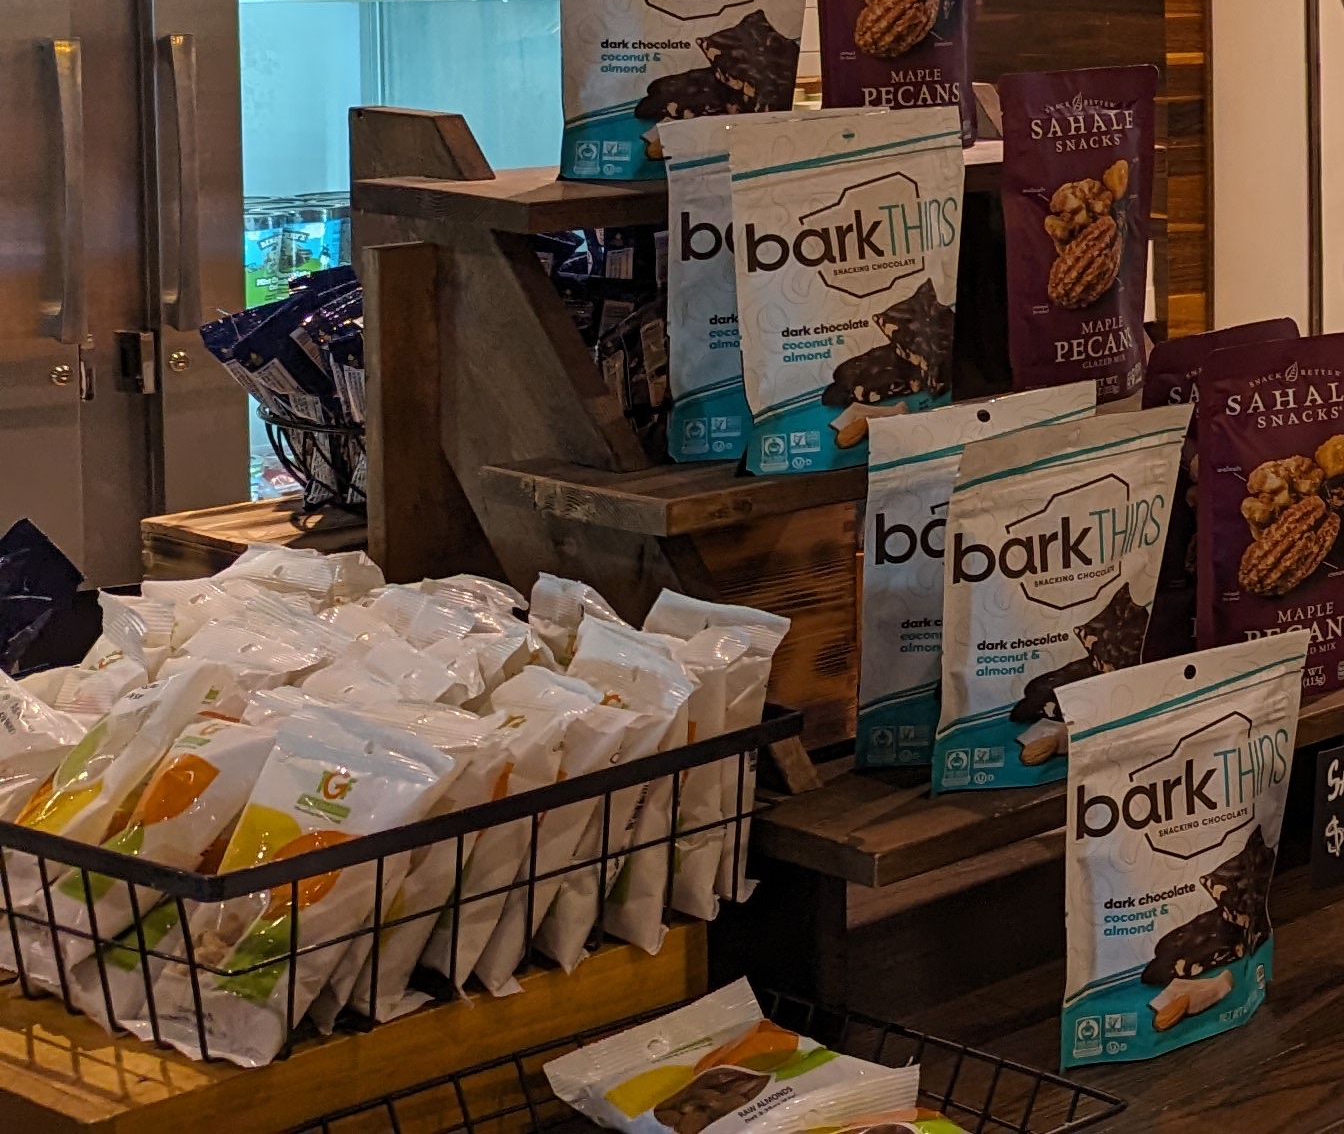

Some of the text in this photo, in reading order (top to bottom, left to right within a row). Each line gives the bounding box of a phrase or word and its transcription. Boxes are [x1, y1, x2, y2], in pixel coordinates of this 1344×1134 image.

[601, 39, 691, 49] dark chocolate
[601, 53, 661, 61] coconut &
[601, 64, 646, 73] almond
[891, 69, 941, 83] MAPLE
[862, 83, 960, 107] PECANS
[1031, 110, 1133, 139] SAHALE
[1056, 134, 1122, 152] SNACKS
[782, 319, 869, 338] dark chocolate
[1081, 316, 1124, 334] MAPLE
[782, 335, 845, 351] coconut &
[783, 349, 831, 362] almond
[1258, 406, 1339, 428] SNACKS
[1277, 602, 1333, 623] MAPLE
[977, 632, 1069, 651] dark chocolate
[1319, 643, 1336, 652] MIX
[977, 650, 1040, 664] coconut &
[976, 664, 1024, 676] almond
[1158, 808, 1248, 837] SNACKING CHOCOLATE
[1104, 883, 1195, 910] dark chocolate
[1104, 904, 1168, 923] coconut &
[1104, 922, 1154, 936] almond
[738, 1106, 756, 1117] RAW
[757, 1086, 793, 1108] ALMONDS
